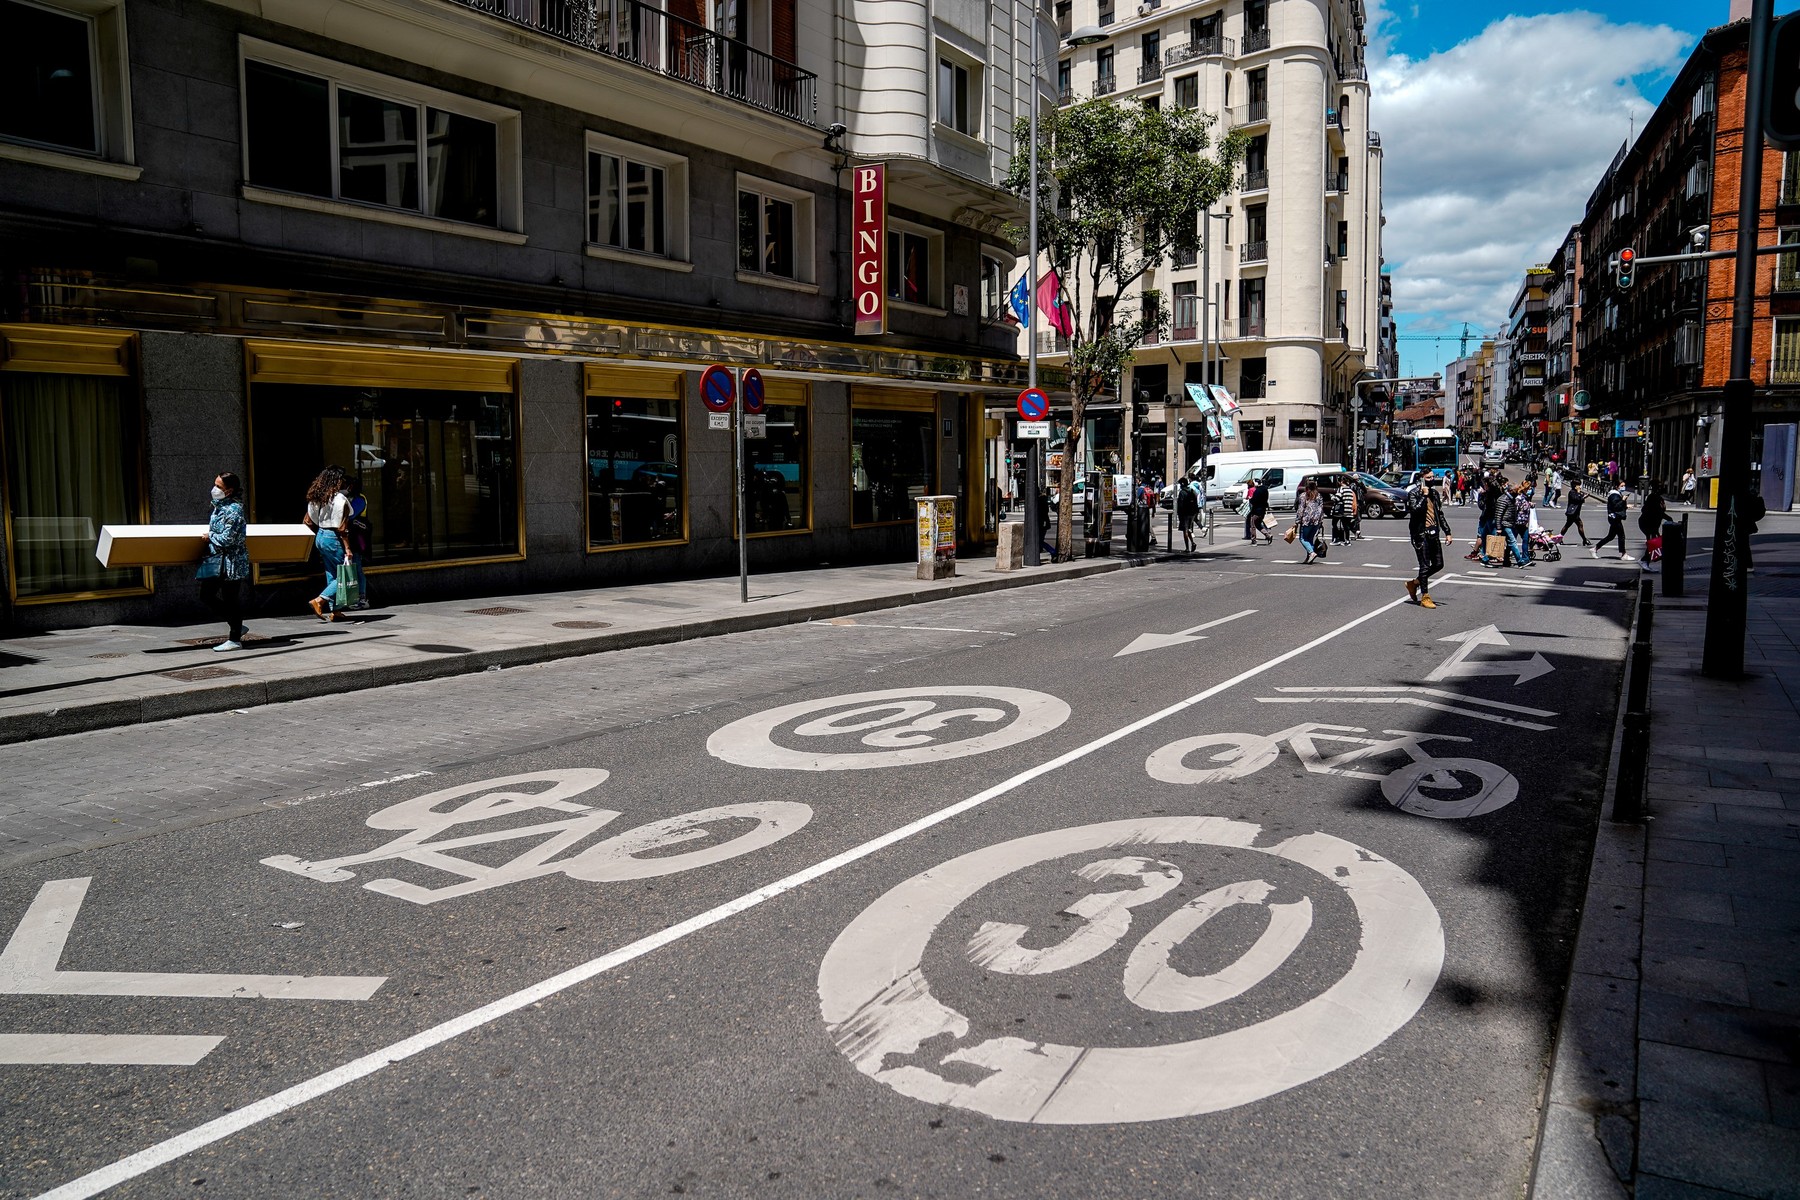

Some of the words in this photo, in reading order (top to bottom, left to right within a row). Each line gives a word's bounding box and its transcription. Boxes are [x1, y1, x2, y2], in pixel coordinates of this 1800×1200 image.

[859, 169, 879, 315] BINGO
[794, 700, 1006, 748] 30
[966, 856, 1313, 1012] 30
